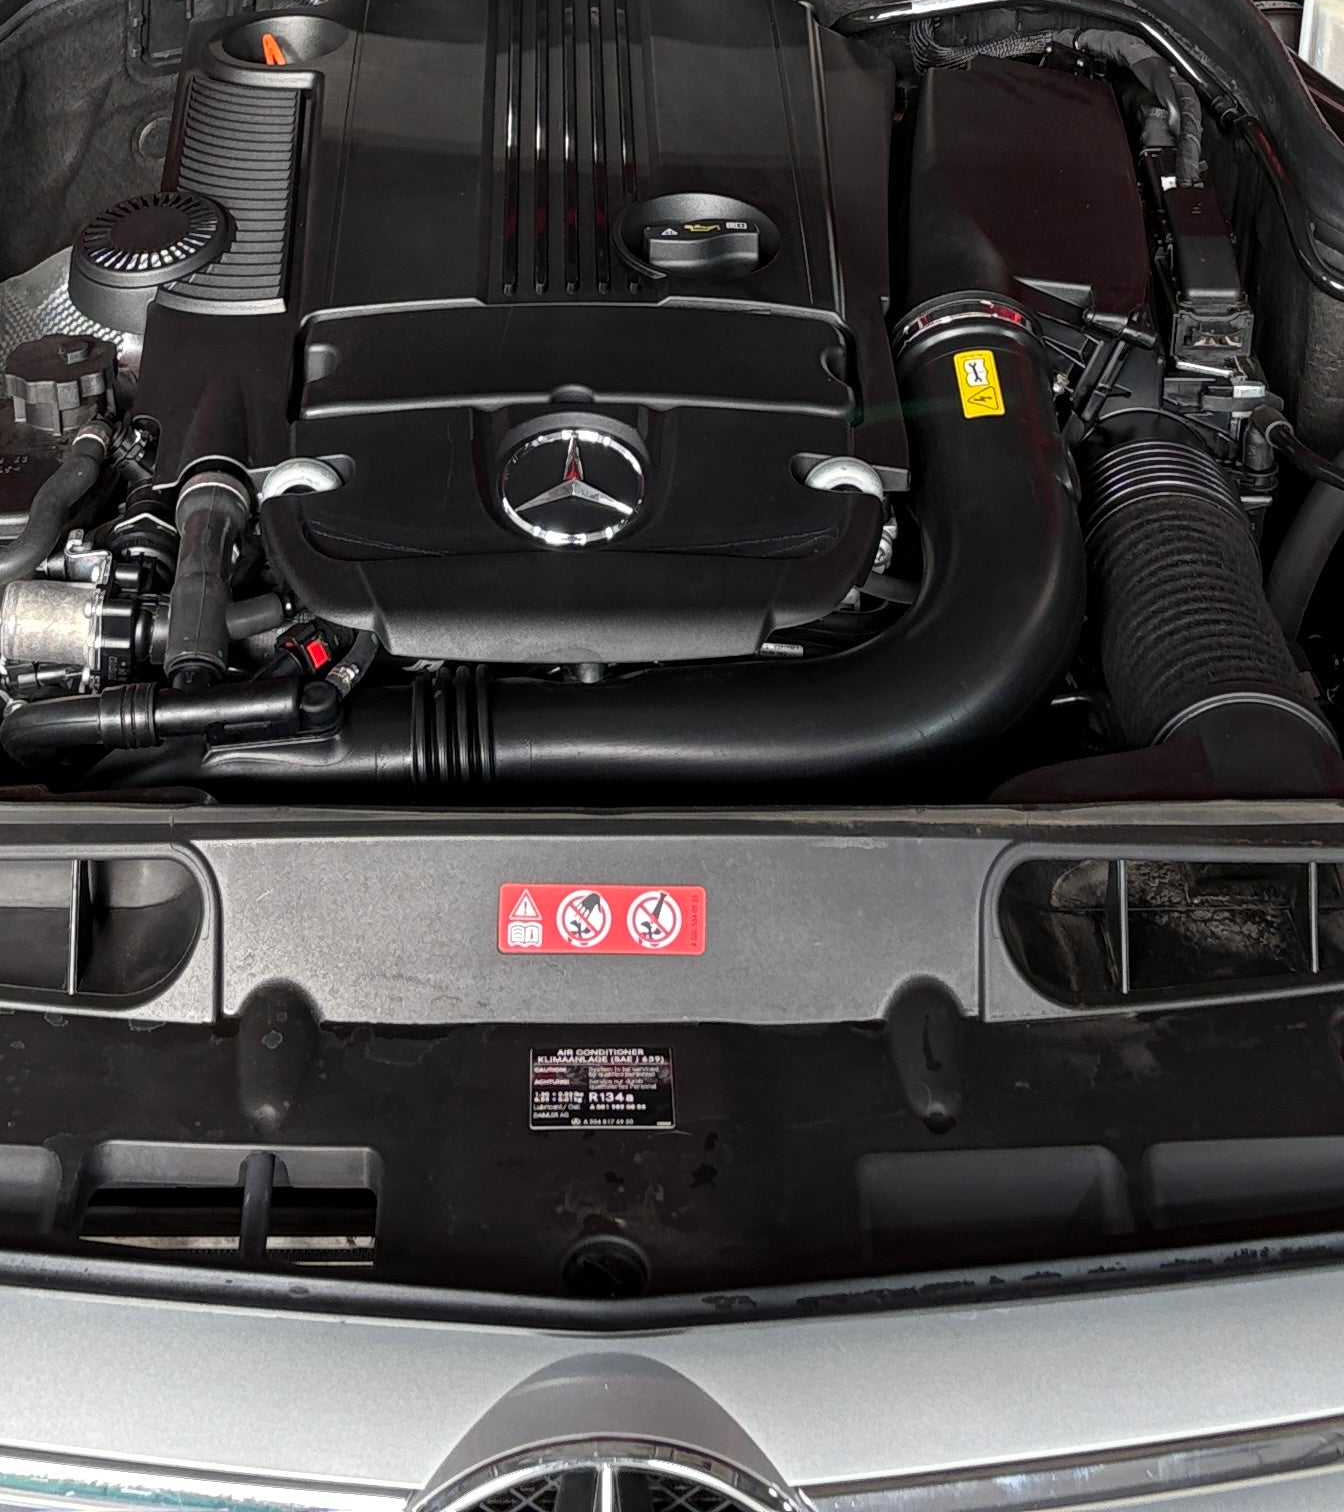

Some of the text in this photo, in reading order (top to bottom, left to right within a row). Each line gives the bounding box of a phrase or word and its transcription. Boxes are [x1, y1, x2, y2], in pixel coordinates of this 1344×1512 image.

[537, 1055, 608, 1064] KLIMAANLAGE
[610, 1055, 632, 1064] (SAE
[641, 1055, 665, 1064] 639)
[588, 1091, 635, 1103] R134a
